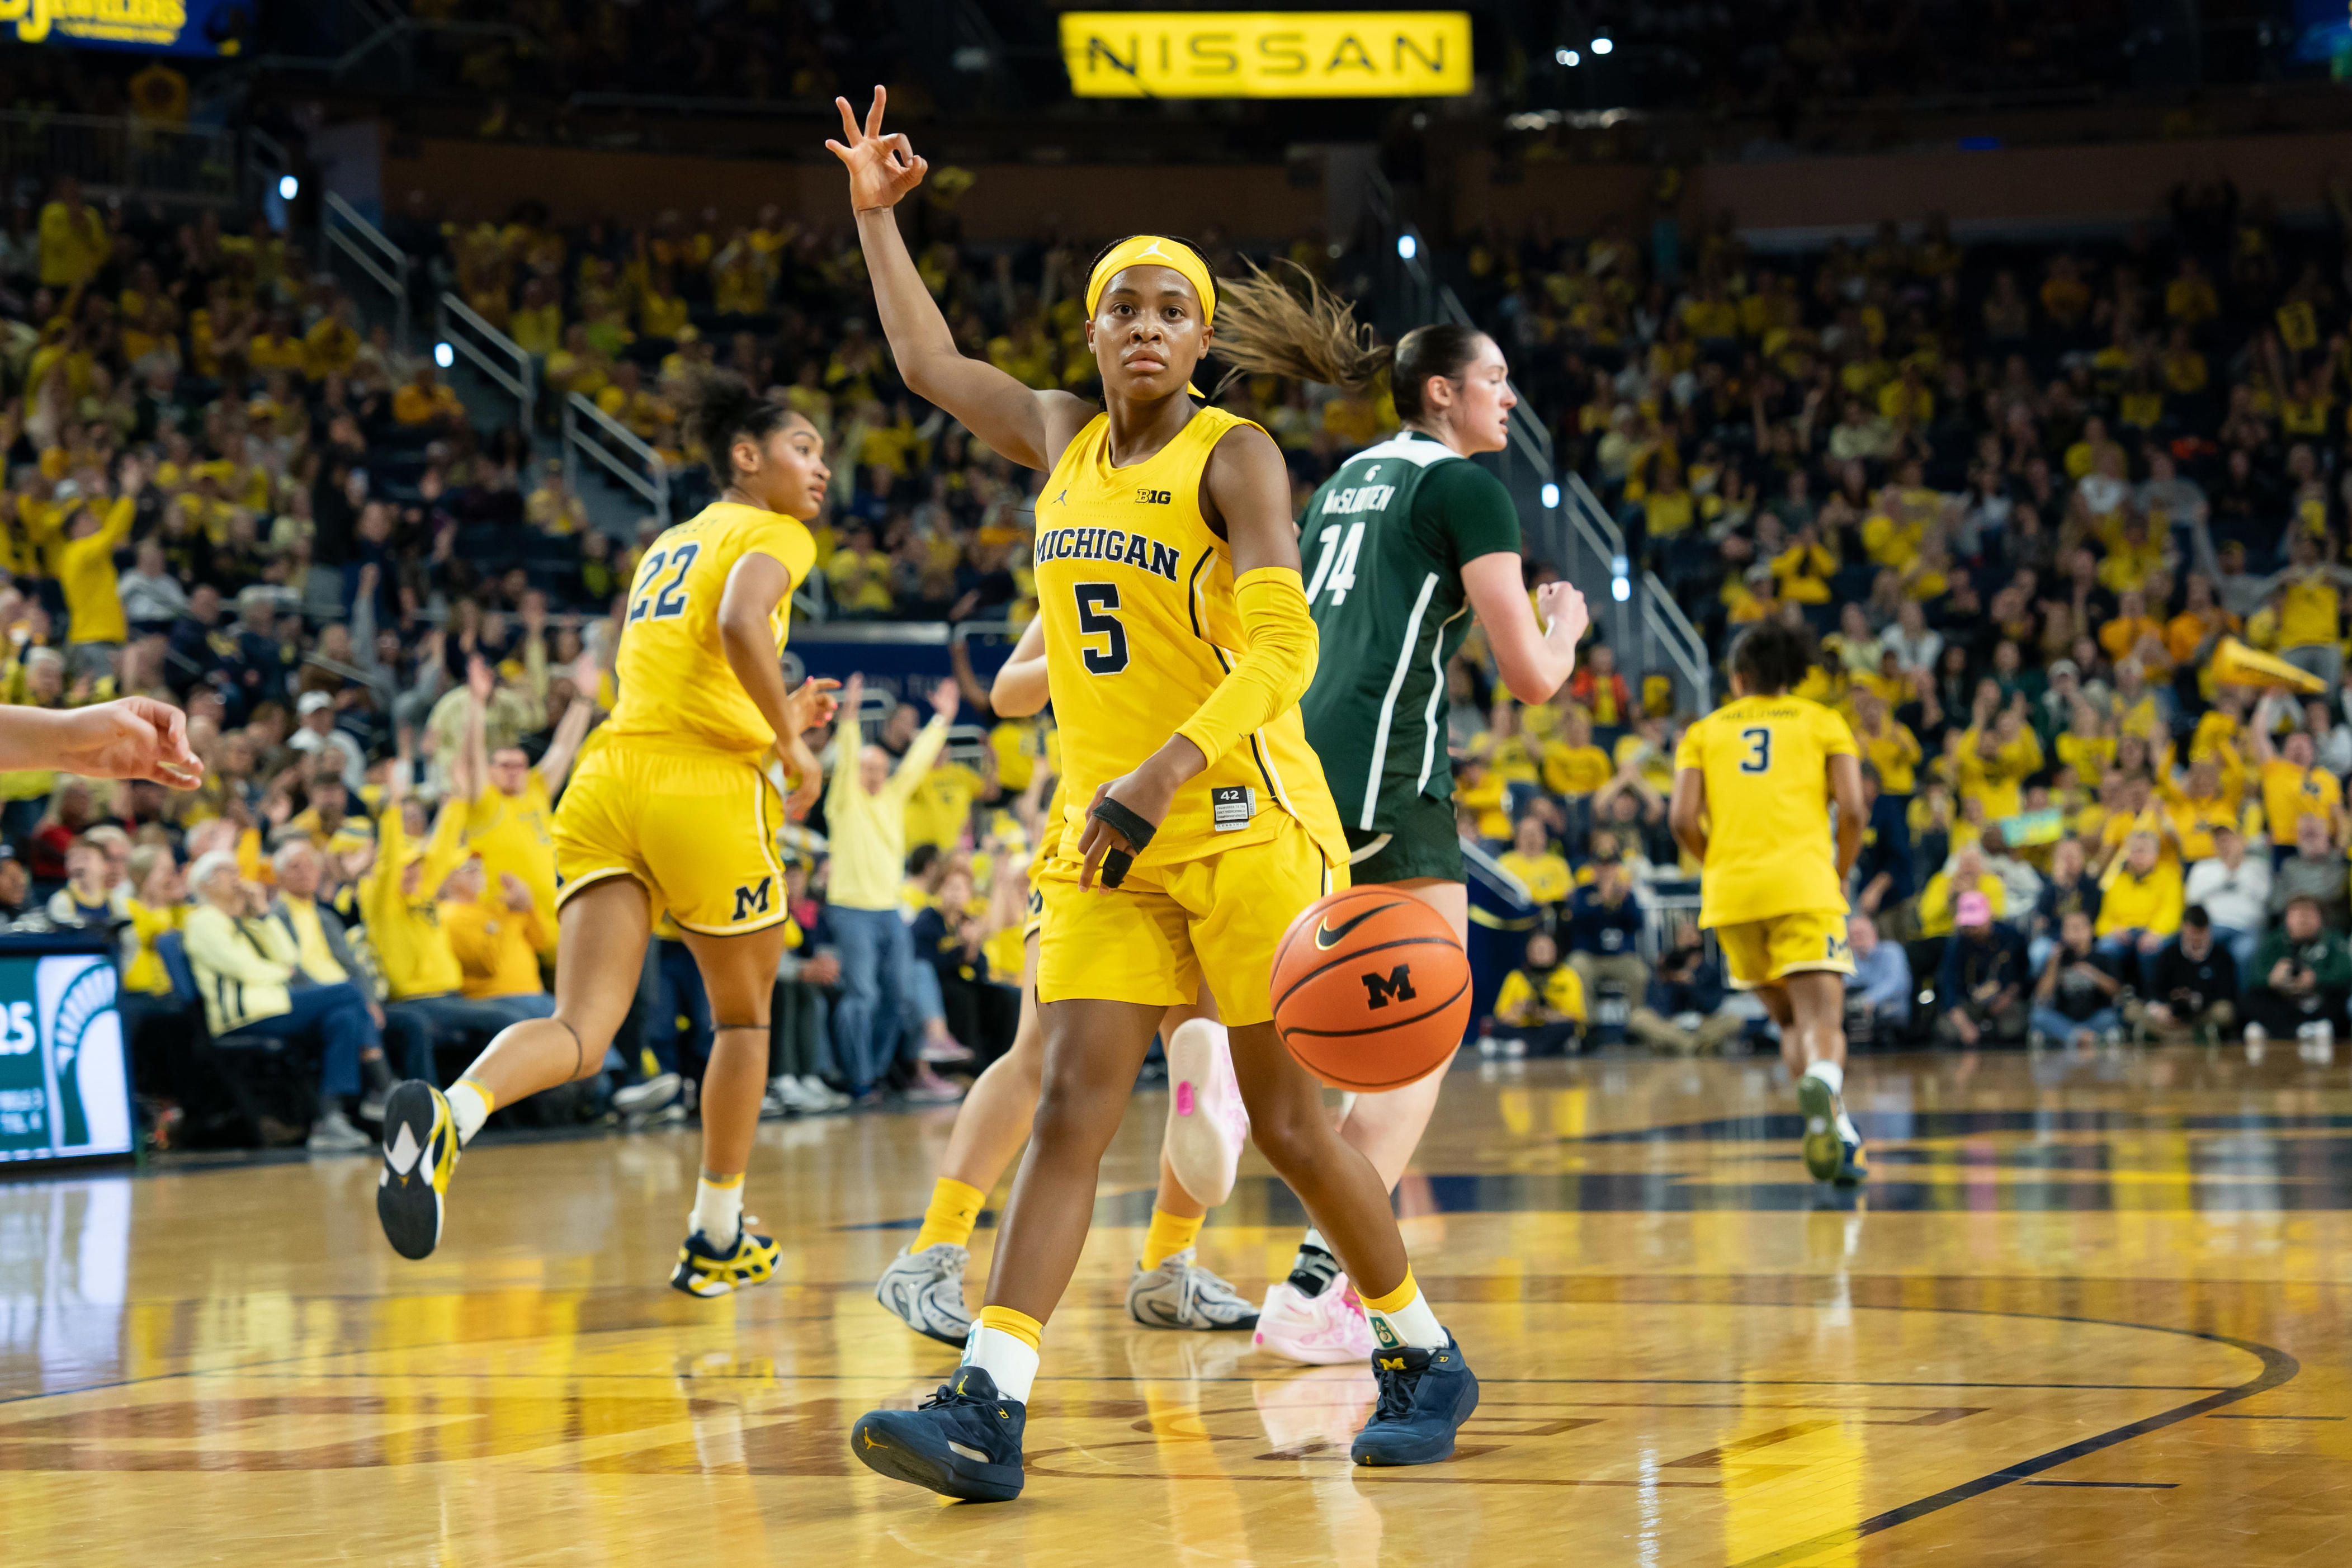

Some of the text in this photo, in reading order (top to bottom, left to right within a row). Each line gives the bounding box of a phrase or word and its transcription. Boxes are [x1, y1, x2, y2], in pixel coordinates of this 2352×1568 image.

[1088, 32, 1444, 75] NISSAN
[1035, 527, 1180, 583] MICHIGAN
[1305, 522, 1366, 606] 14
[629, 542, 701, 622] 22
[1073, 582, 1130, 676] 5
[1741, 727, 1770, 773] 3
[1220, 790, 1239, 800] 42
[732, 876, 771, 921] M
[1361, 963, 1416, 1010] M
[1379, 1357, 1407, 1371] M
